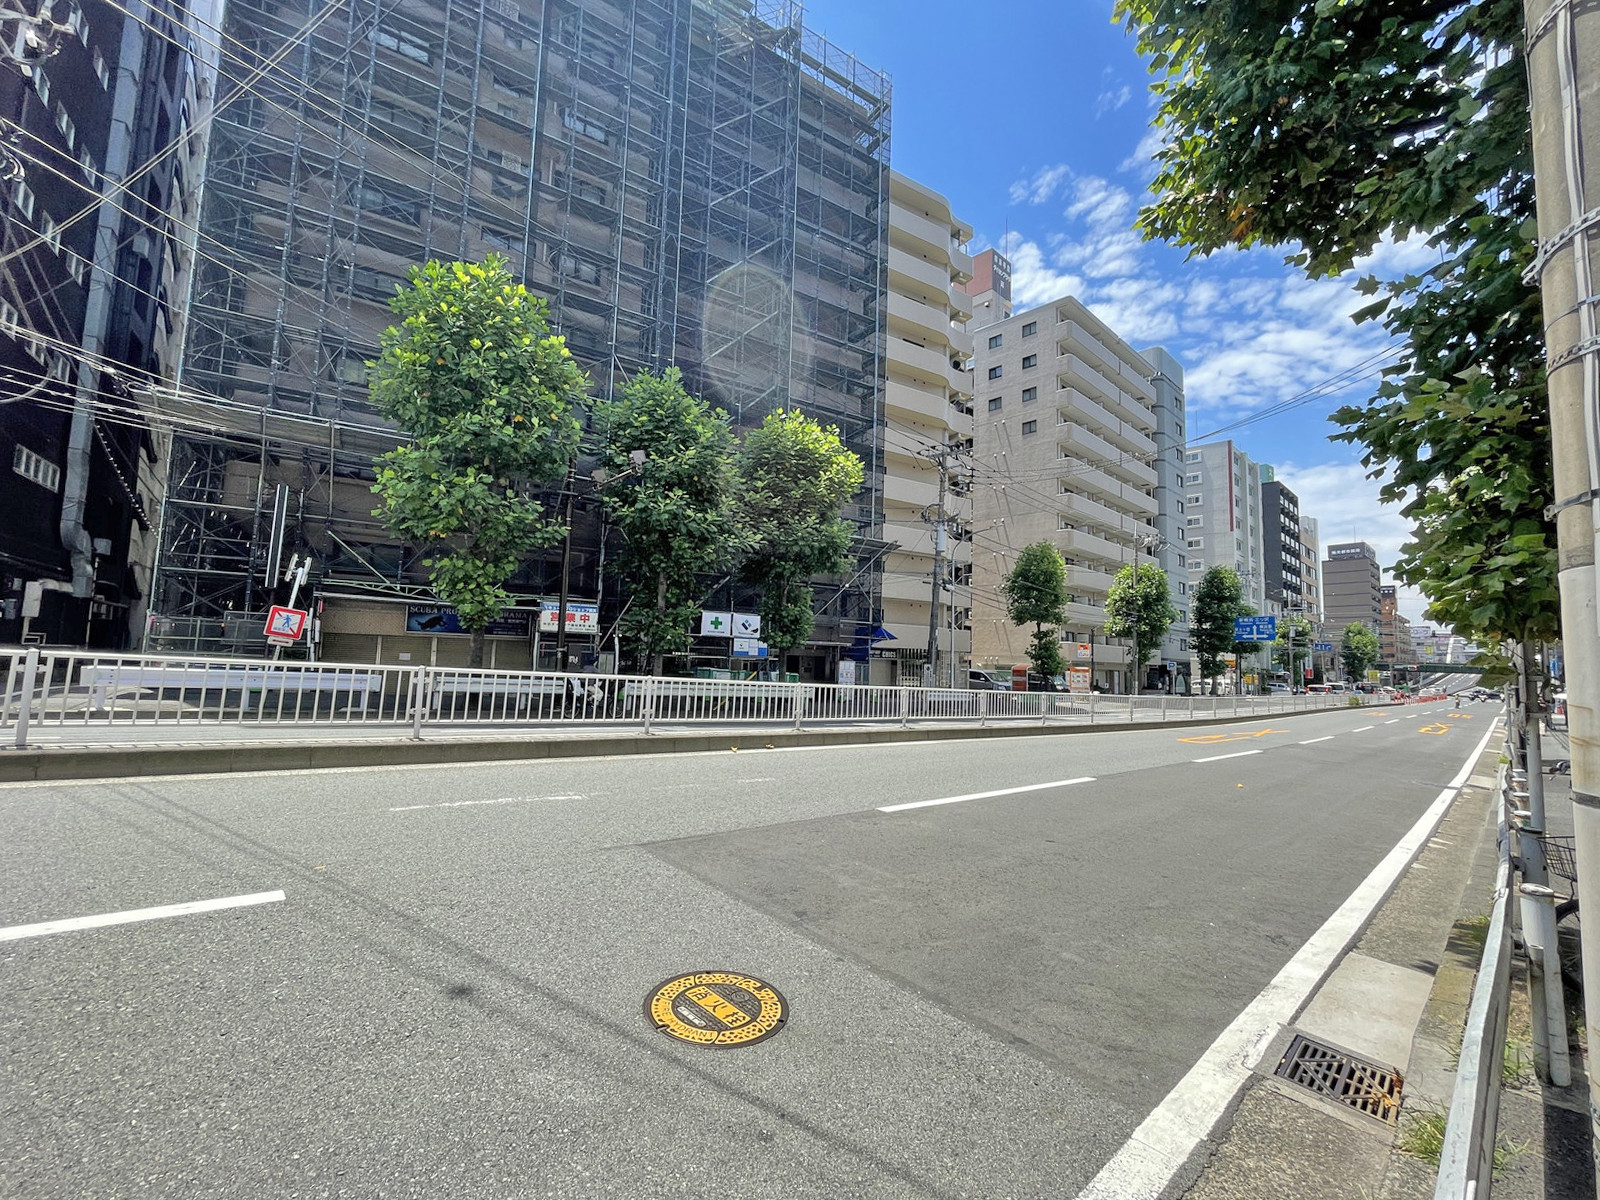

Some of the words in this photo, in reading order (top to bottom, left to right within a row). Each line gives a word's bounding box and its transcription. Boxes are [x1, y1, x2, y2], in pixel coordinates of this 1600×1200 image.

[409, 605, 438, 614] SCUBA
[550, 611, 590, 623] 営業中
[686, 986, 749, 1026] 消火栓
[668, 1018, 714, 1038] HYDRANT
